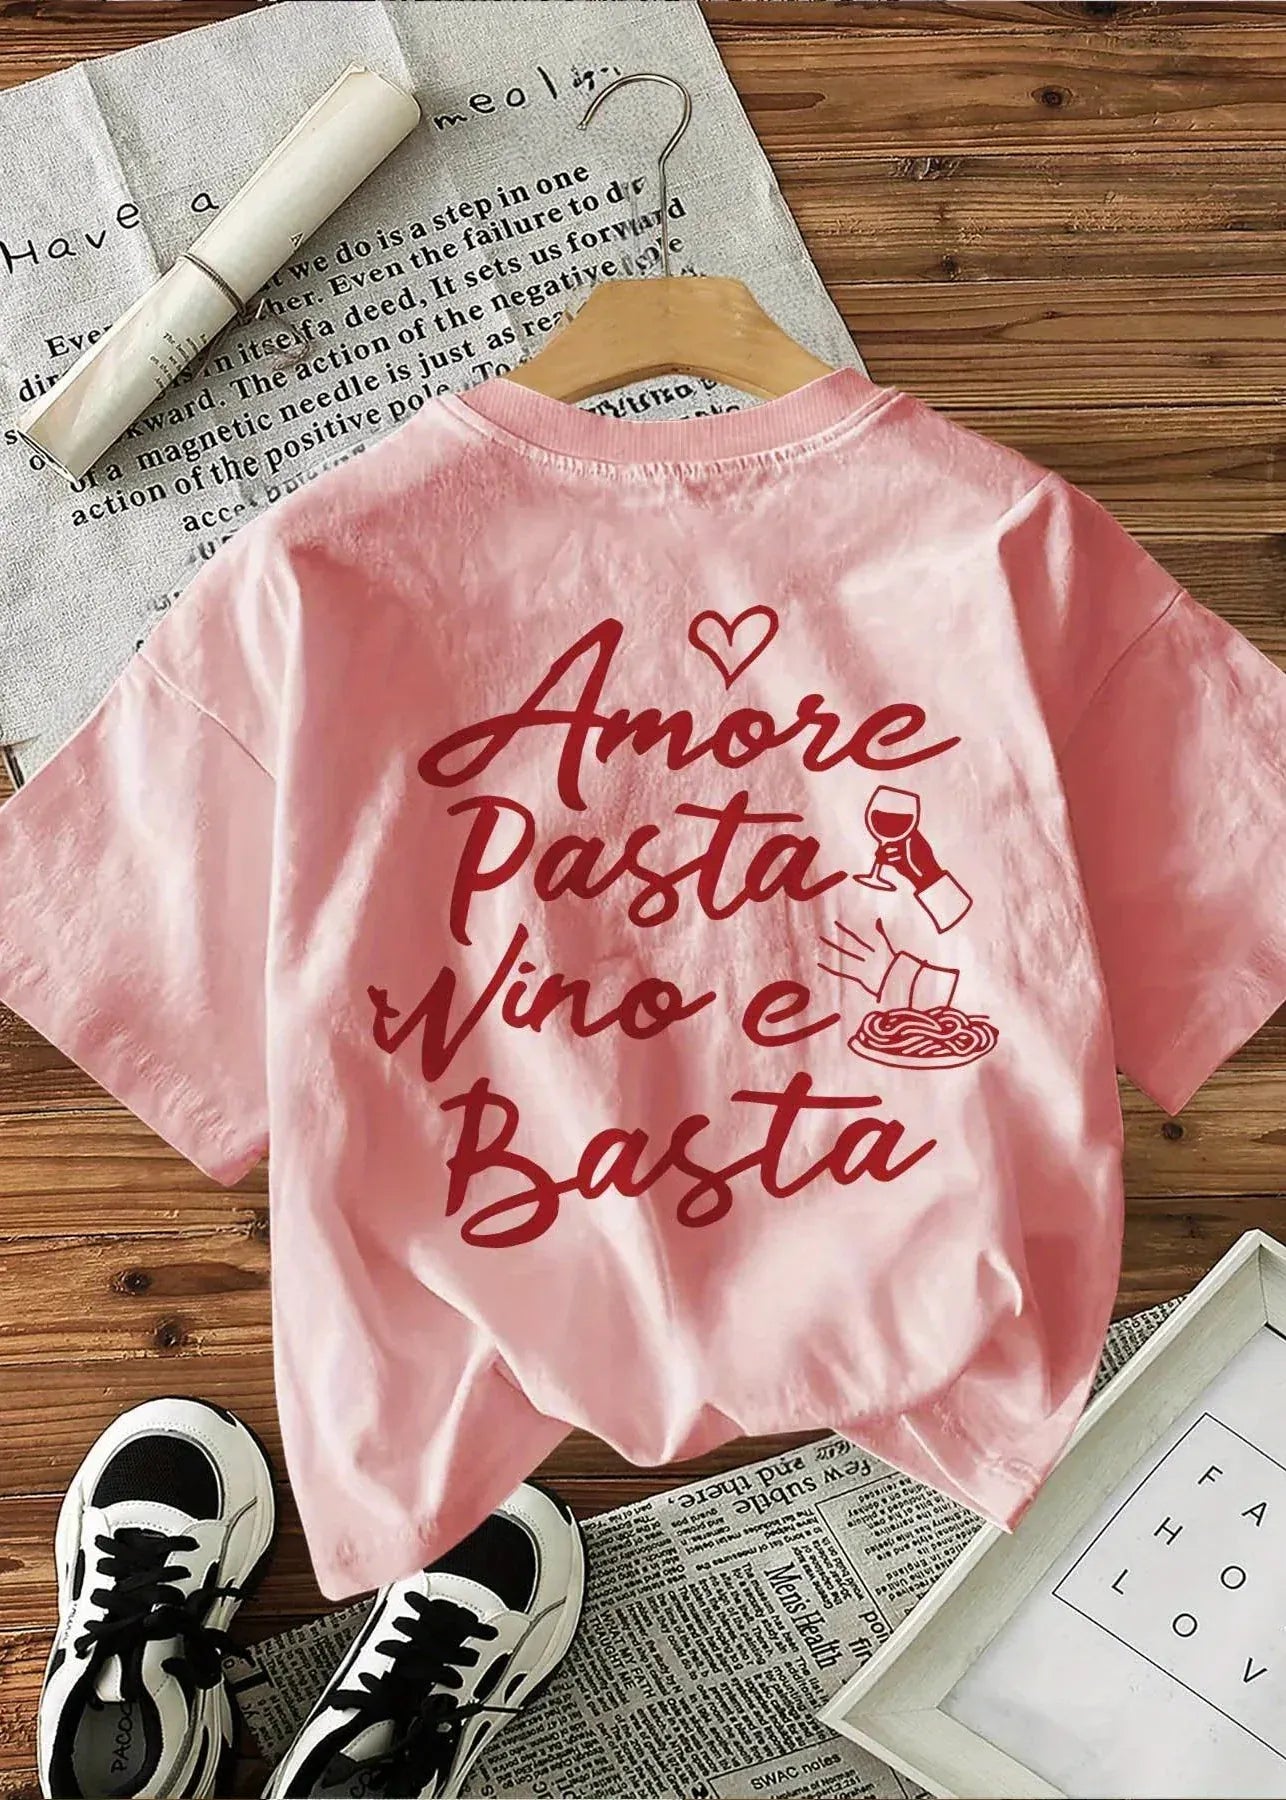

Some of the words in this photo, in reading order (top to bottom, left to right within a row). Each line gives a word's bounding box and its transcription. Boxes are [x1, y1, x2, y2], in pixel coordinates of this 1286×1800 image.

[287, 257, 328, 280] we
[337, 242, 370, 263] do
[377, 230, 403, 249] is
[410, 223, 427, 239] a
[433, 199, 491, 230] step
[498, 186, 530, 207] in
[537, 167, 589, 194] one
[328, 263, 404, 296] Even
[410, 244, 458, 268] the
[463, 208, 563, 250] failure
[568, 196, 598, 215] to
[230, 372, 287, 399] The
[296, 337, 390, 380] action
[398, 318, 426, 343] of
[434, 306, 483, 332] the
[491, 261, 617, 312] negative
[346, 287, 426, 327] deed,
[429, 276, 456, 299] It
[465, 258, 521, 287] sets
[529, 244, 562, 265] us
[106, 464, 123, 481] a
[136, 413, 272, 470] magnetic
[279, 376, 379, 422] needle
[386, 363, 411, 383] is
[419, 340, 475, 378] just
[487, 327, 514, 349] as
[72, 485, 166, 526] action
[175, 466, 204, 494] of
[210, 456, 258, 484] the
[265, 409, 381, 474] positive
[418, 617, 959, 812] Amore
[447, 791, 848, 947] Pasta
[742, 980, 842, 1048] e
[440, 1071, 938, 1250] Basta
[669, 1476, 752, 1508] there,
[733, 1477, 817, 1514] subtle
[824, 1460, 871, 1483] few
[791, 1610, 842, 1670] Health
[751, 1767, 799, 1790] SWAC
